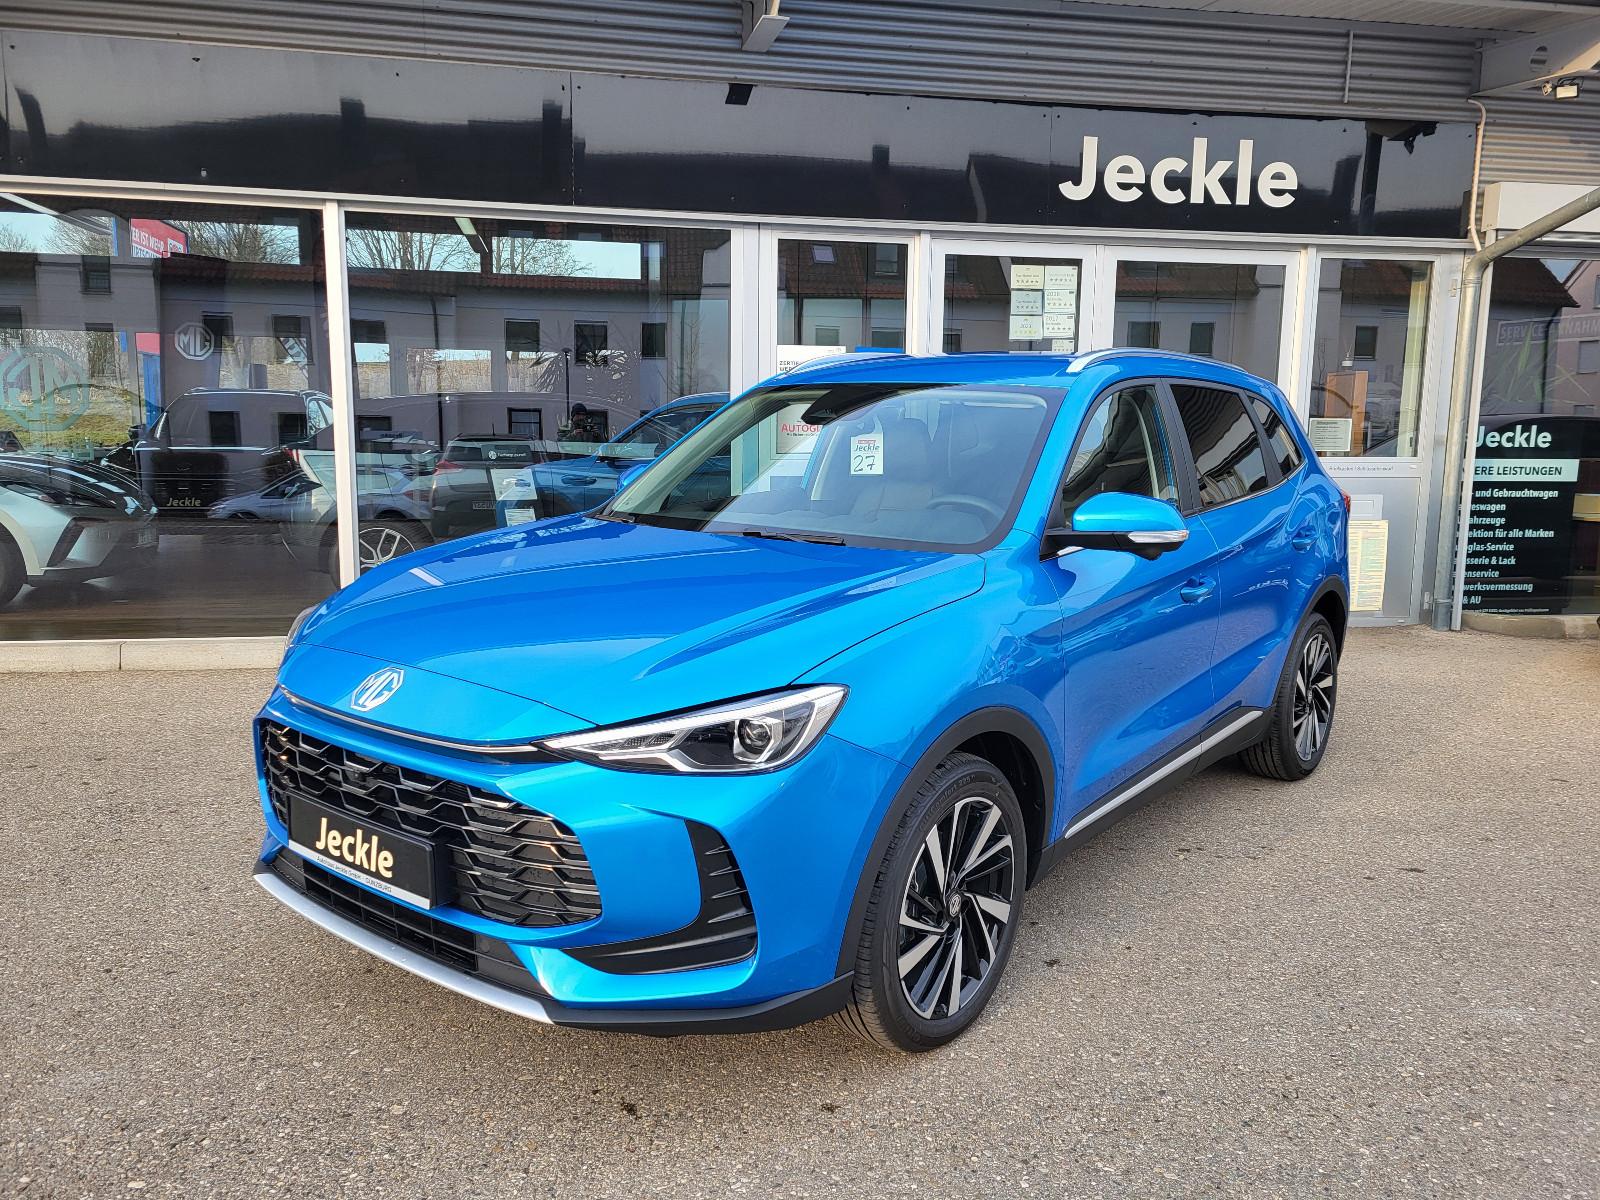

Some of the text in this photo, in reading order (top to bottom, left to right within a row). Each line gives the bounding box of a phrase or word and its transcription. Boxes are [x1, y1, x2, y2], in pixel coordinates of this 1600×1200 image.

[1058, 135, 1299, 208] Jeckle
[177, 324, 212, 358] MG
[1475, 424, 1552, 448] Jeckle
[855, 443, 880, 452] Jeckle
[853, 454, 876, 473] 27
[1496, 466, 1563, 476] LEISTUNGEN
[1475, 488, 1559, 500] und Gebrauchtwagen
[166, 496, 201, 507] Jeckle
[1471, 503, 1507, 514] eswagen
[1494, 528, 1508, 538] für
[1508, 528, 1524, 538] alle
[1524, 528, 1555, 538] Marken
[1467, 542, 1515, 554] glas-Service
[1466, 555, 1517, 565] sserie & Lack
[1464, 568, 1500, 578] enservice
[1463, 581, 1534, 593] werksvermessung
[1470, 595, 1482, 605] AU
[354, 669, 401, 709] MG
[315, 817, 394, 879] Jeckle
